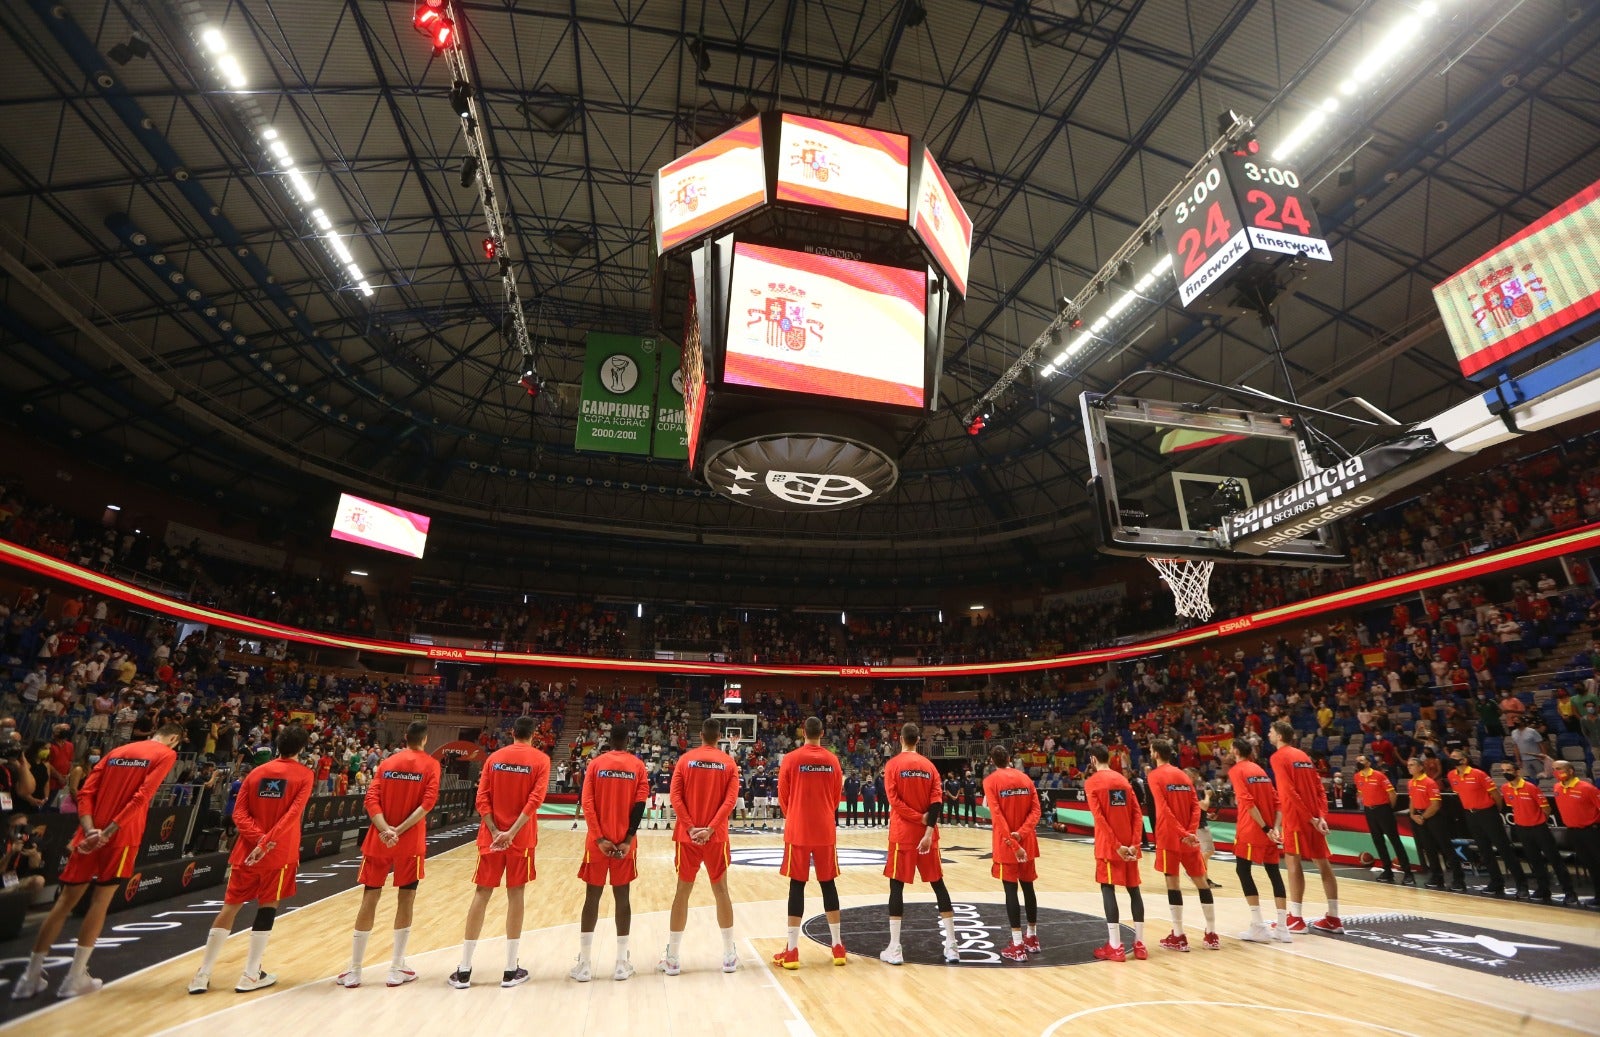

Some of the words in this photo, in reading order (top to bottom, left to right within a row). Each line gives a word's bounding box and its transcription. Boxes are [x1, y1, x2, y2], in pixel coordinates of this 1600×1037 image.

[1244, 162, 1299, 188] 3:00
[1175, 168, 1220, 224] 3:00
[1246, 189, 1311, 235] 24
[1177, 201, 1231, 278] 24
[1256, 233, 1325, 255] finetwork
[1185, 241, 1244, 298] finetwork
[582, 400, 650, 419] CAMPEONES
[584, 414, 611, 425] COPA
[657, 422, 683, 432] COPA
[591, 428, 637, 440] 2000/2001
[1273, 499, 1316, 524] SEGUROS
[1220, 618, 1251, 633] ESPAÑA
[430, 649, 463, 658] ESPAÑA
[728, 689, 740, 698] 24
[115, 758, 147, 768] CaixaBank
[500, 764, 530, 774] CaixaBank
[697, 761, 724, 770] CaixaBank
[392, 771, 421, 781] CaixaBank
[606, 770, 635, 779] CaixaBank
[907, 770, 930, 779] CaixaBank
[1344, 930, 1508, 967] CaixaBank
